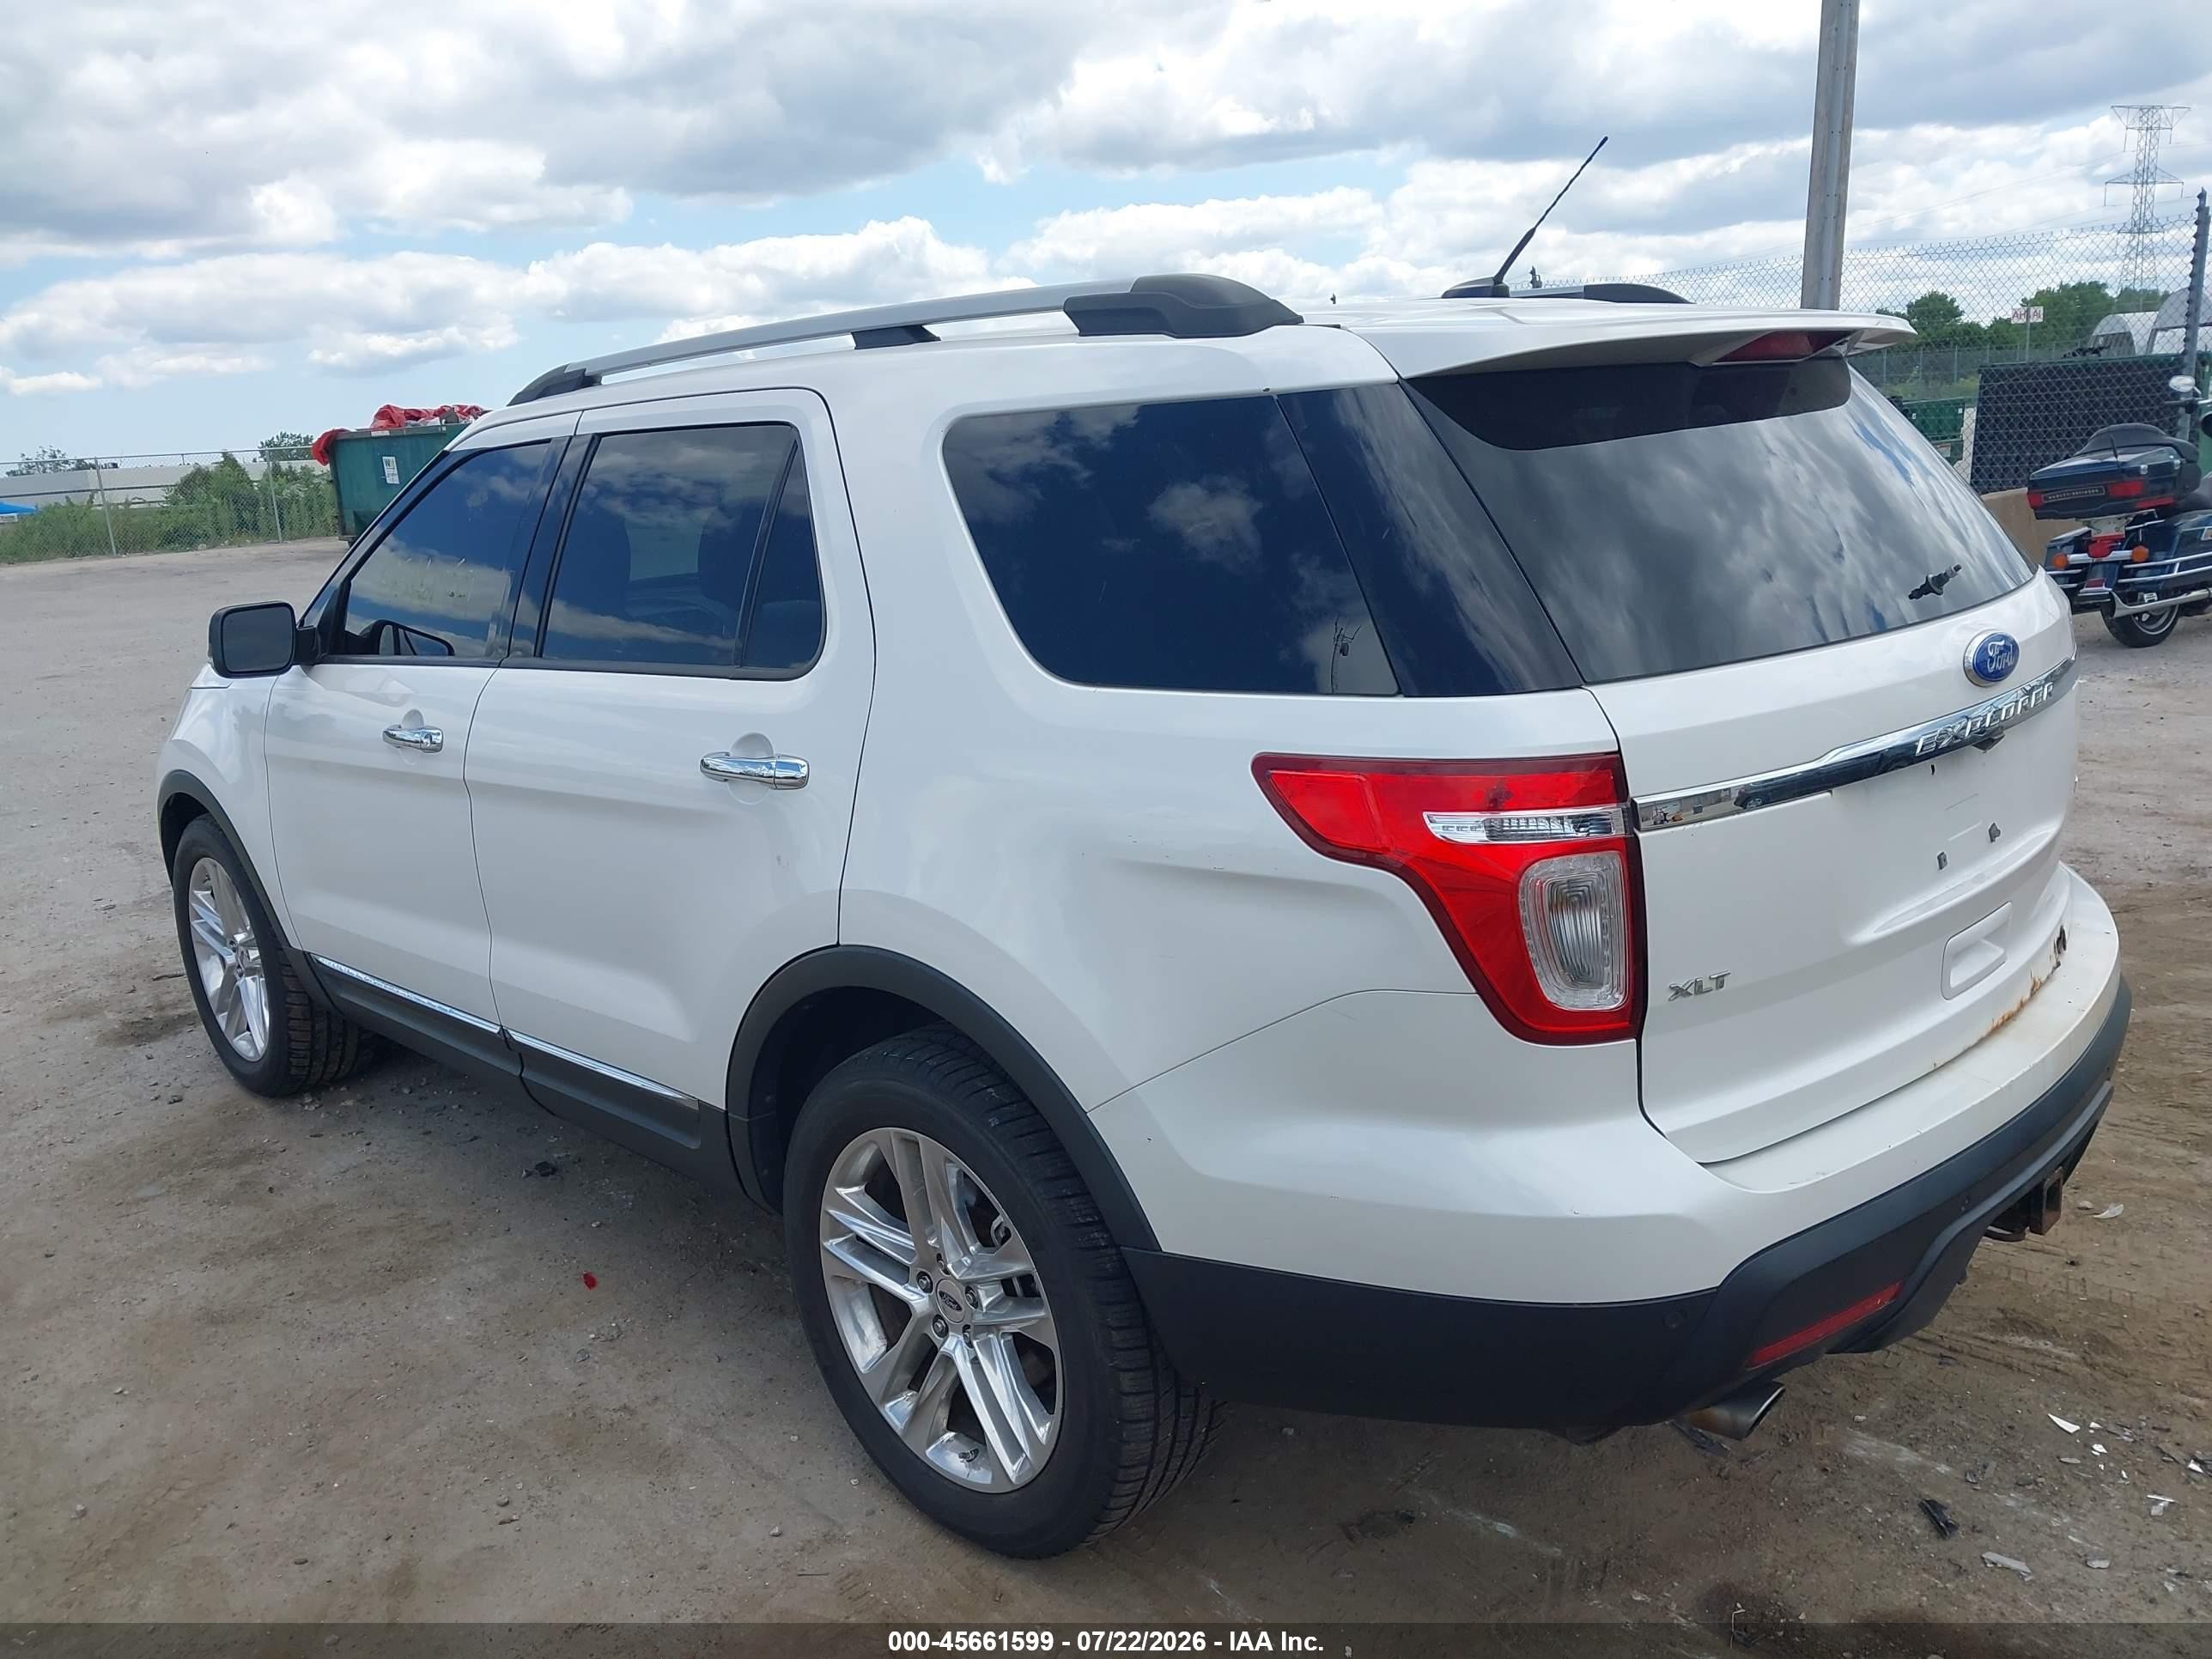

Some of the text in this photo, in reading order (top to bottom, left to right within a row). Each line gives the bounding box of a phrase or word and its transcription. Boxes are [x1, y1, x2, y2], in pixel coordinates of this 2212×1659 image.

[1987, 639, 2014, 673] Ford
[1915, 682, 2054, 757] EXPLORER
[1668, 970, 1731, 1002] XLT
